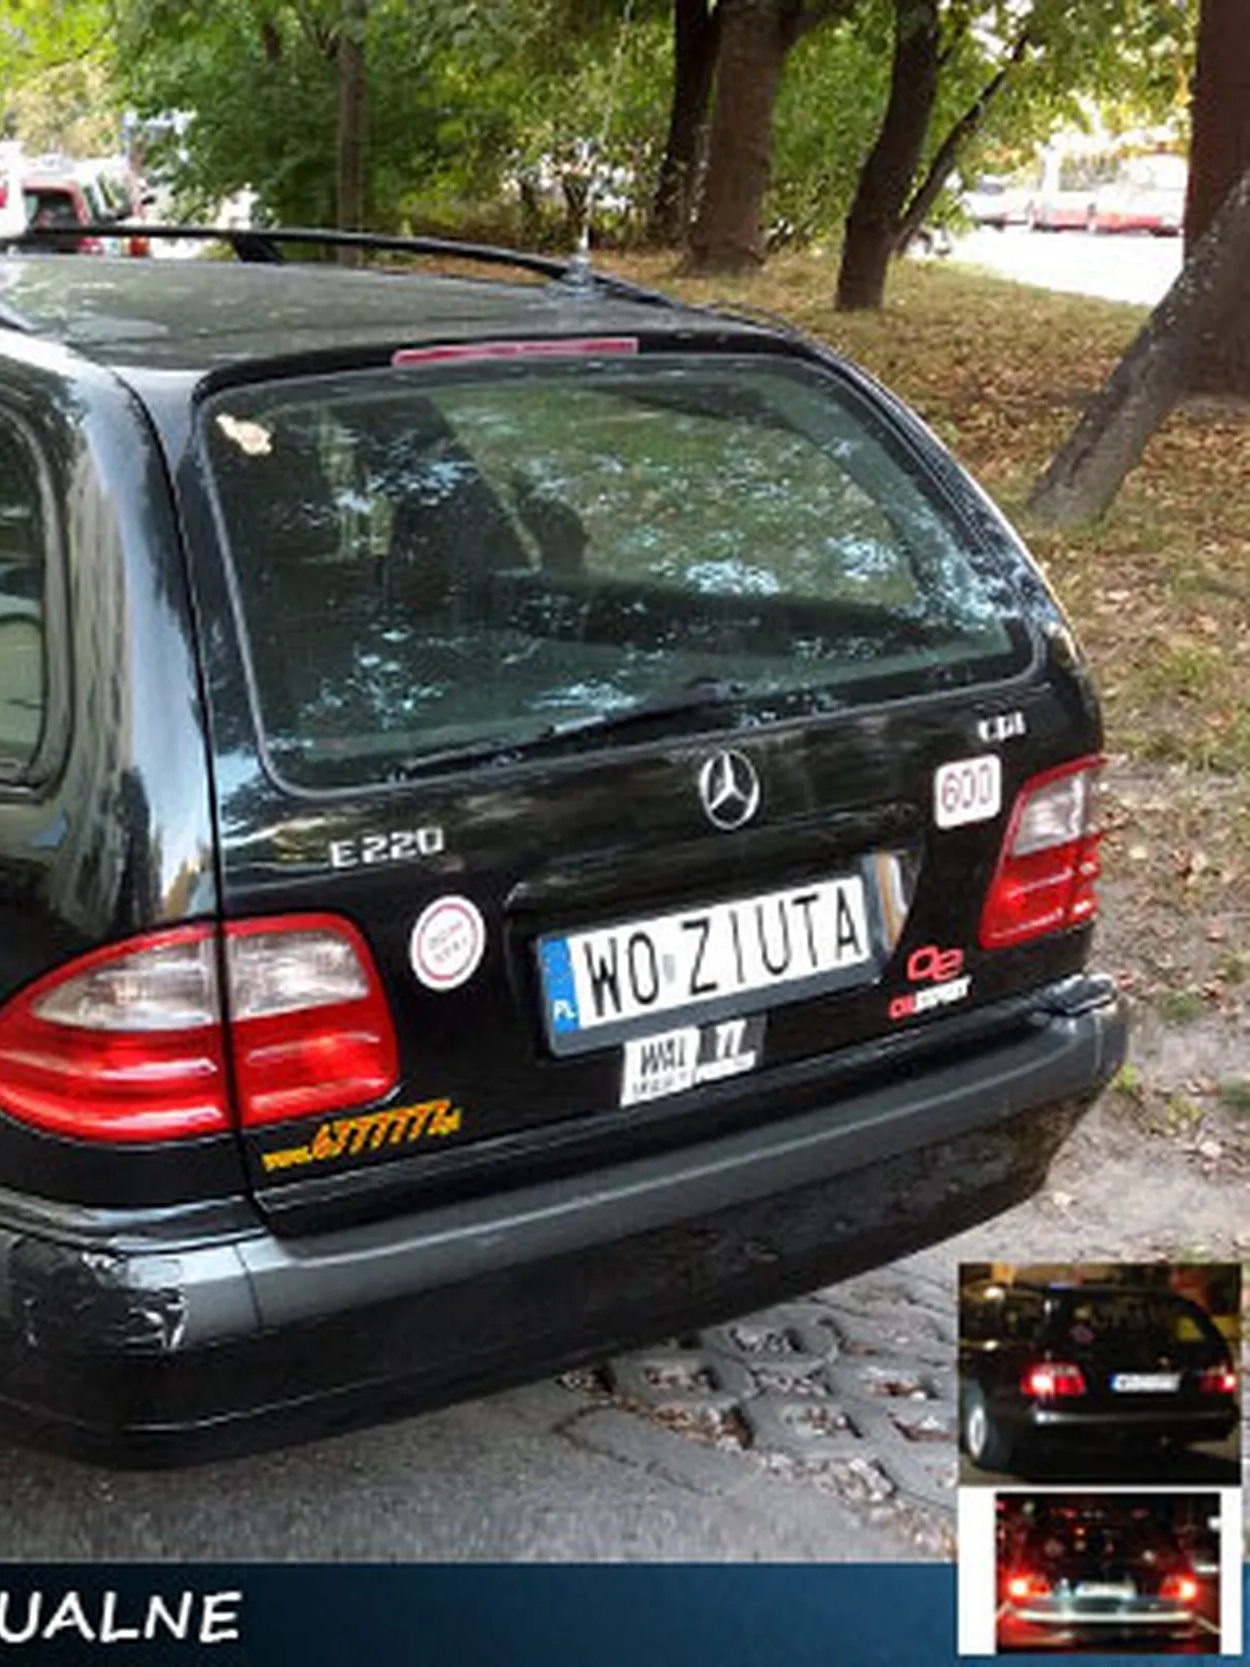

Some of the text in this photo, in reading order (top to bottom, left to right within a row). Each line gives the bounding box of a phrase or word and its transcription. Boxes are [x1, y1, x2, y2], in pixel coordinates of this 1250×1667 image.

[941, 763, 993, 813] 600
[553, 886, 863, 1021] PL WO ZIUTA
